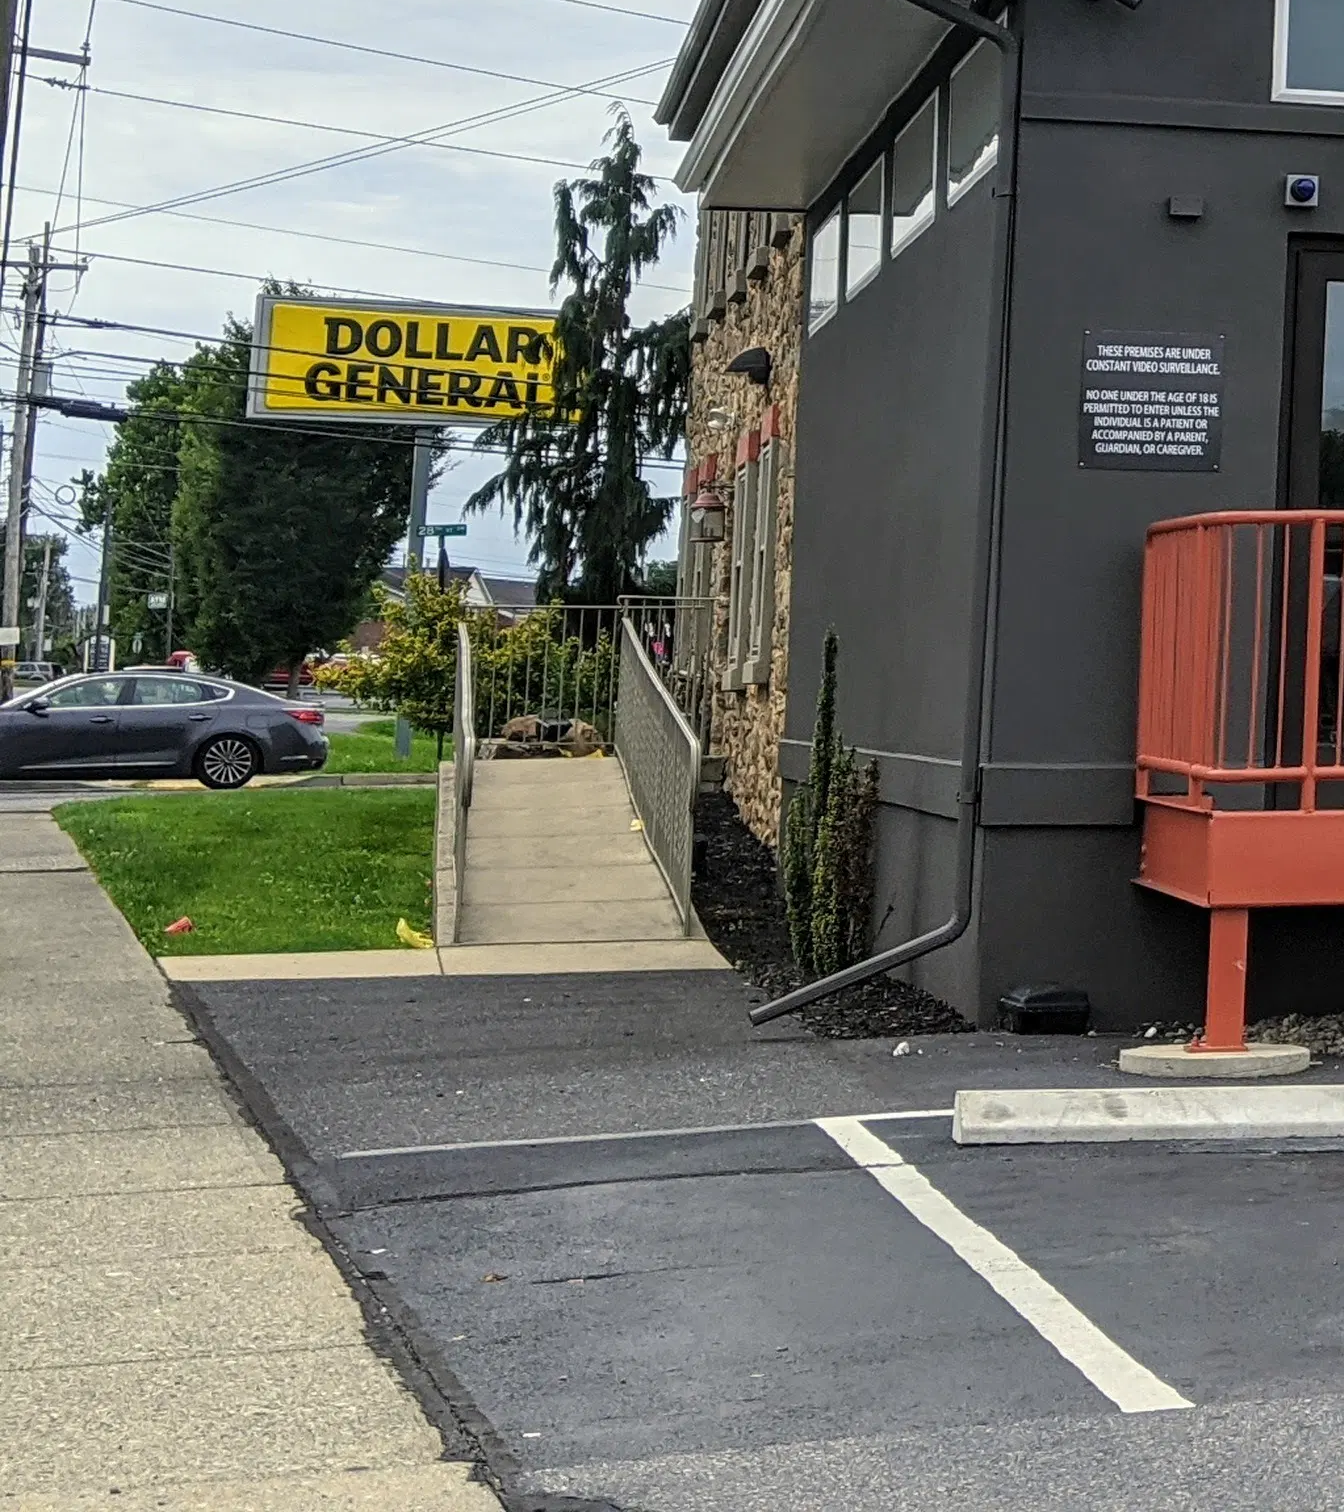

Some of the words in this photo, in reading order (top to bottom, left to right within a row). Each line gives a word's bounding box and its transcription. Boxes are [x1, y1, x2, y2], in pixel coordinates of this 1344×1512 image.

[323, 316, 543, 364] DOLLAR
[1097, 345, 1124, 357] THESE
[1124, 346, 1164, 358] PREMISES
[1165, 348, 1181, 359] ARE
[1182, 348, 1211, 360] UNDER
[1086, 359, 1132, 372] CONSTANT
[1133, 361, 1158, 373] VIDEO
[1159, 362, 1221, 375] SURVEILLANCE.
[304, 361, 544, 409] GENERAL
[1086, 390, 1100, 400] NO
[1101, 390, 1119, 401] ONE
[1120, 391, 1149, 402] UNDER
[1150, 391, 1166, 402] THE
[1167, 392, 1184, 403] AGE
[1185, 393, 1197, 403] OF
[1199, 393, 1208, 403] 18
[1209, 393, 1218, 404] IS
[1083, 403, 1130, 414] PERMITTED
[1131, 404, 1143, 414] TO
[1144, 405, 1170, 415] ENTER
[1171, 405, 1202, 416] UNLESS
[1203, 406, 1219, 417] THE
[1094, 417, 1142, 428] INDIVIDUAL
[1144, 418, 1151, 428] IS
[1153, 418, 1159, 428] A
[1160, 418, 1194, 429] PATIENT
[1195, 419, 1208, 429] OR
[1091, 430, 1153, 441] ACCOMPANIED
[1154, 431, 1165, 441] BY
[1166, 431, 1173, 441] A
[1174, 431, 1208, 443] PARENT,
[1095, 442, 1142, 455] GUARDIAN,
[1143, 444, 1156, 454] OR
[1157, 444, 1204, 456] CAREGIVER.
